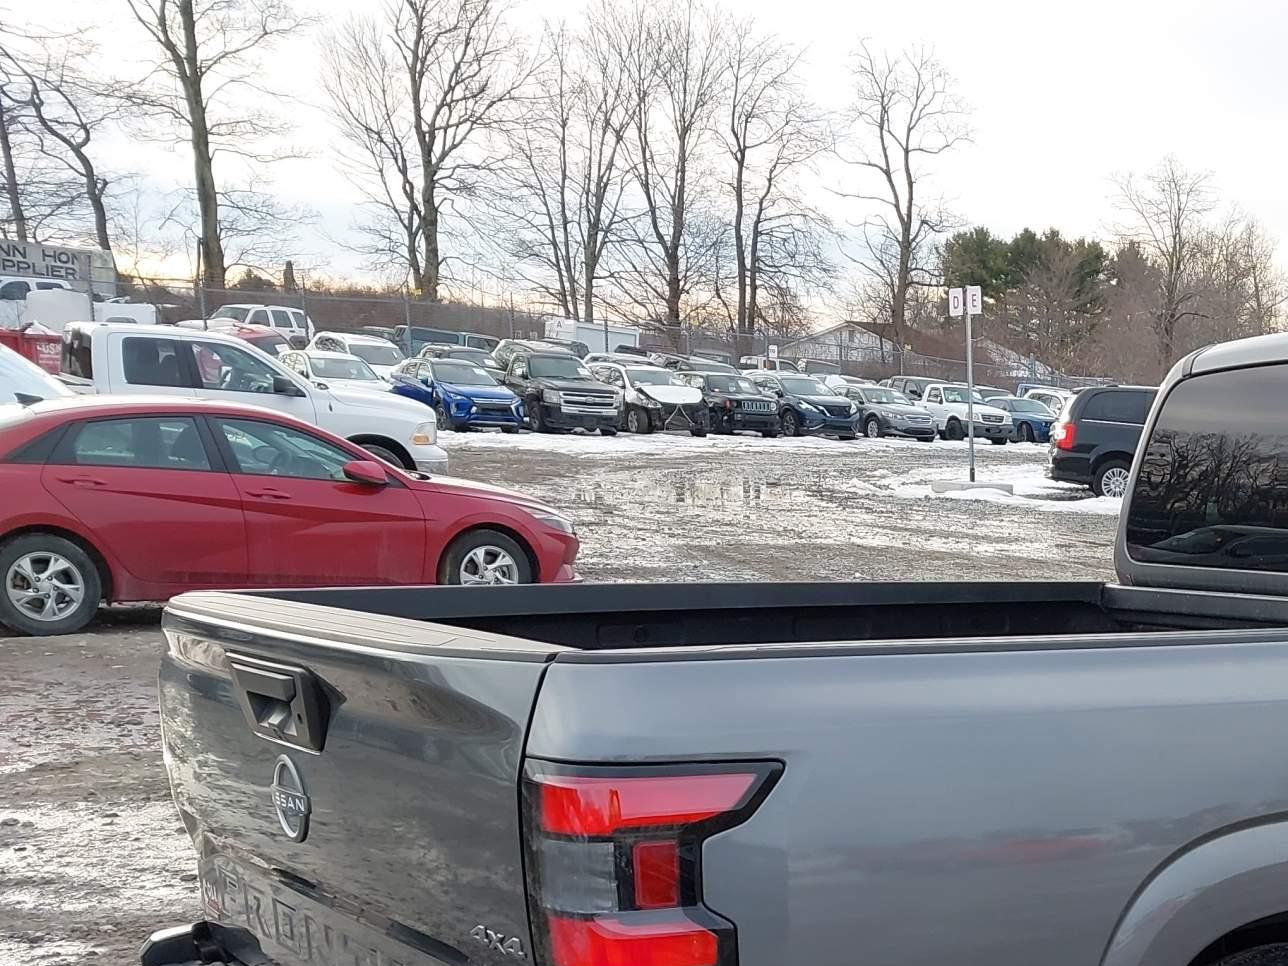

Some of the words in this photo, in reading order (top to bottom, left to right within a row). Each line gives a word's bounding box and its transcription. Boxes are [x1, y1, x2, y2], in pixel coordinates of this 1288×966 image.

[953, 296, 960, 310] D
[972, 294, 978, 308] E
[274, 791, 305, 812] SSAN
